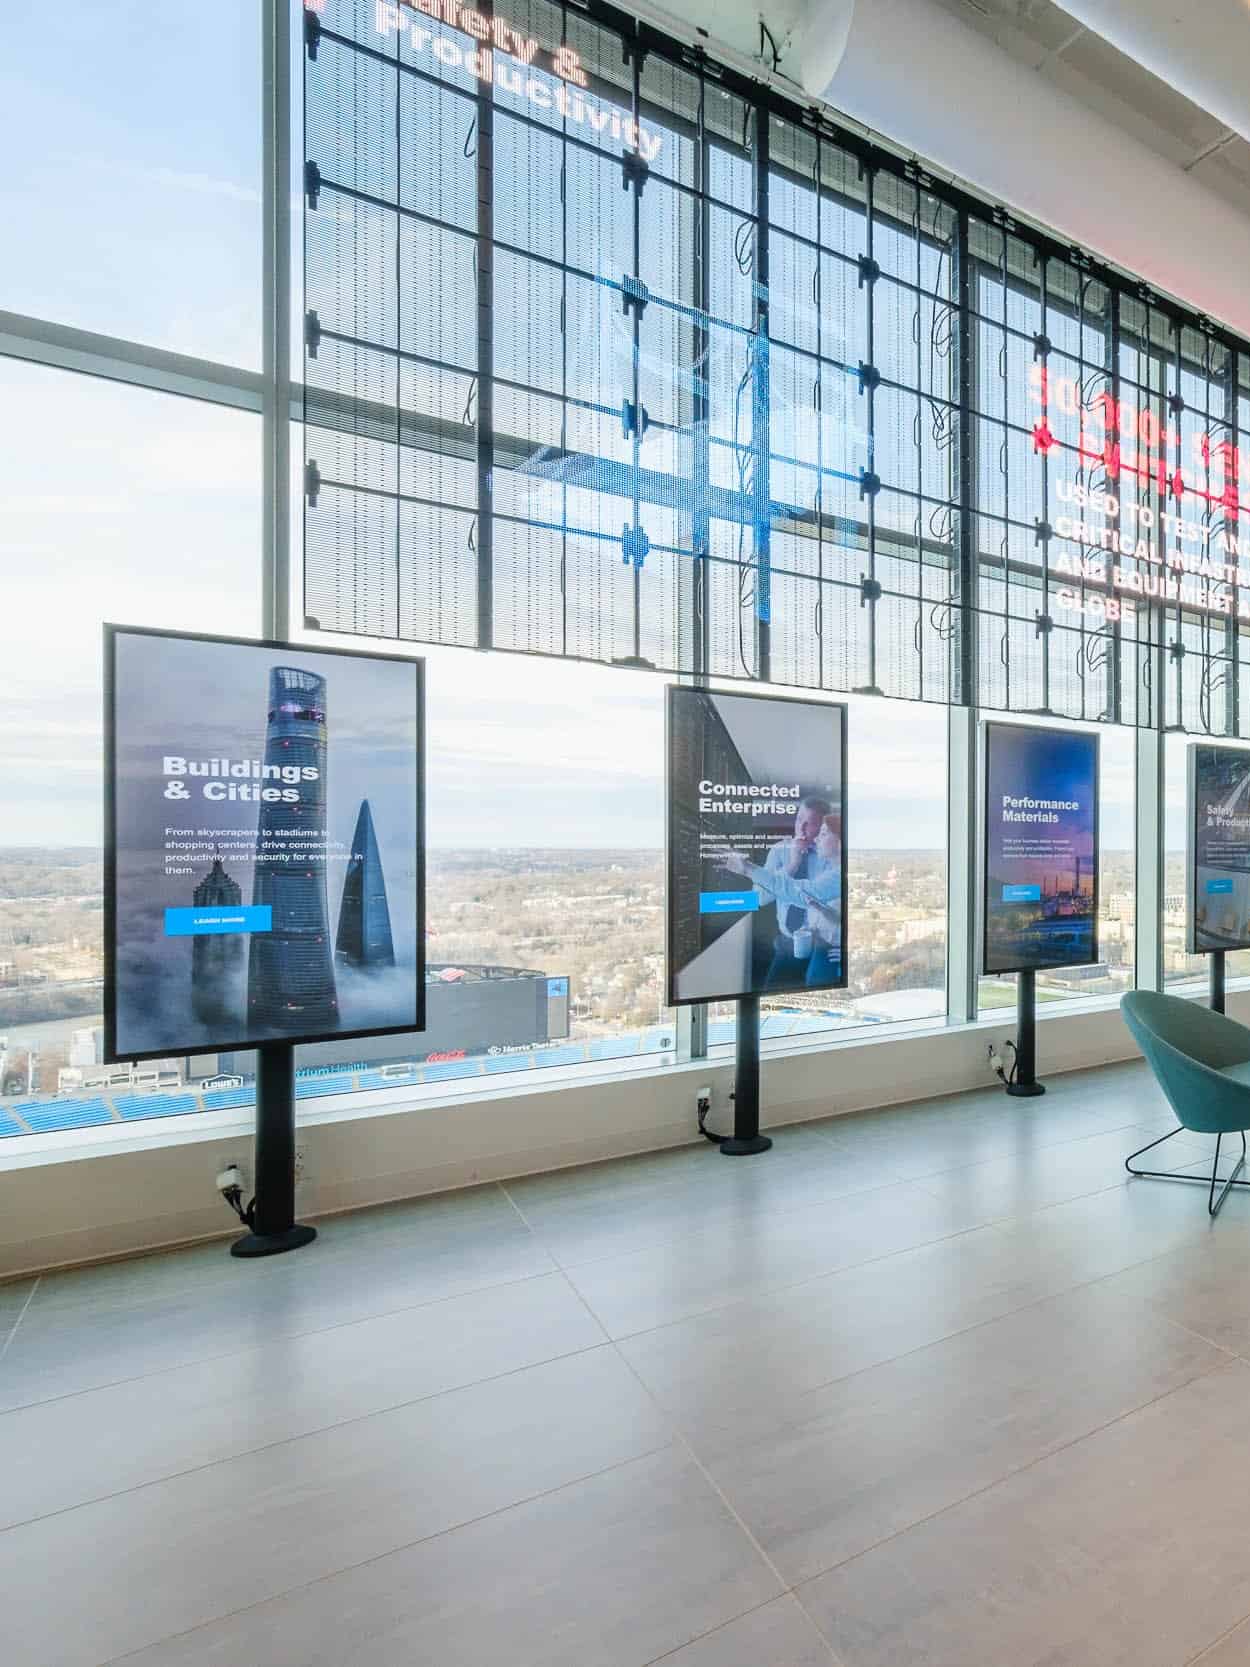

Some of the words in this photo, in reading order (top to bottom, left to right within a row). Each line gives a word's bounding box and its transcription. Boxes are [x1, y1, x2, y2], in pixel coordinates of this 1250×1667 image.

[551, 46, 587, 87] &
[375, 2, 661, 161] Productivity
[1055, 478, 1119, 518] USED
[1126, 502, 1154, 528] TO
[1159, 511, 1210, 544] TEST
[1055, 516, 1162, 565] CRITICAL
[1055, 552, 1106, 584] AND
[1112, 564, 1234, 615] EQUIPMENT
[1056, 589, 1137, 624] GLOBE
[162, 756, 320, 785] Buildings
[163, 780, 192, 801] &
[202, 781, 301, 803] Cities
[698, 780, 801, 798] Connected
[698, 797, 798, 818] Enterprise
[1002, 795, 1080, 811] Performance
[1207, 804, 1234, 818] Safety
[1002, 809, 1060, 824] Materials
[165, 827, 194, 837] From
[197, 827, 260, 840] skyscrapers
[262, 828, 273, 837] to
[275, 827, 319, 837] stadiums
[165, 840, 215, 852] shopping
[262, 840, 287, 850] drive
[165, 853, 226, 864] productivity
[229, 853, 250, 862] and
[253, 853, 290, 864] security
[293, 852, 307, 862] for
[354, 852, 364, 861] in
[165, 866, 196, 876] them.
